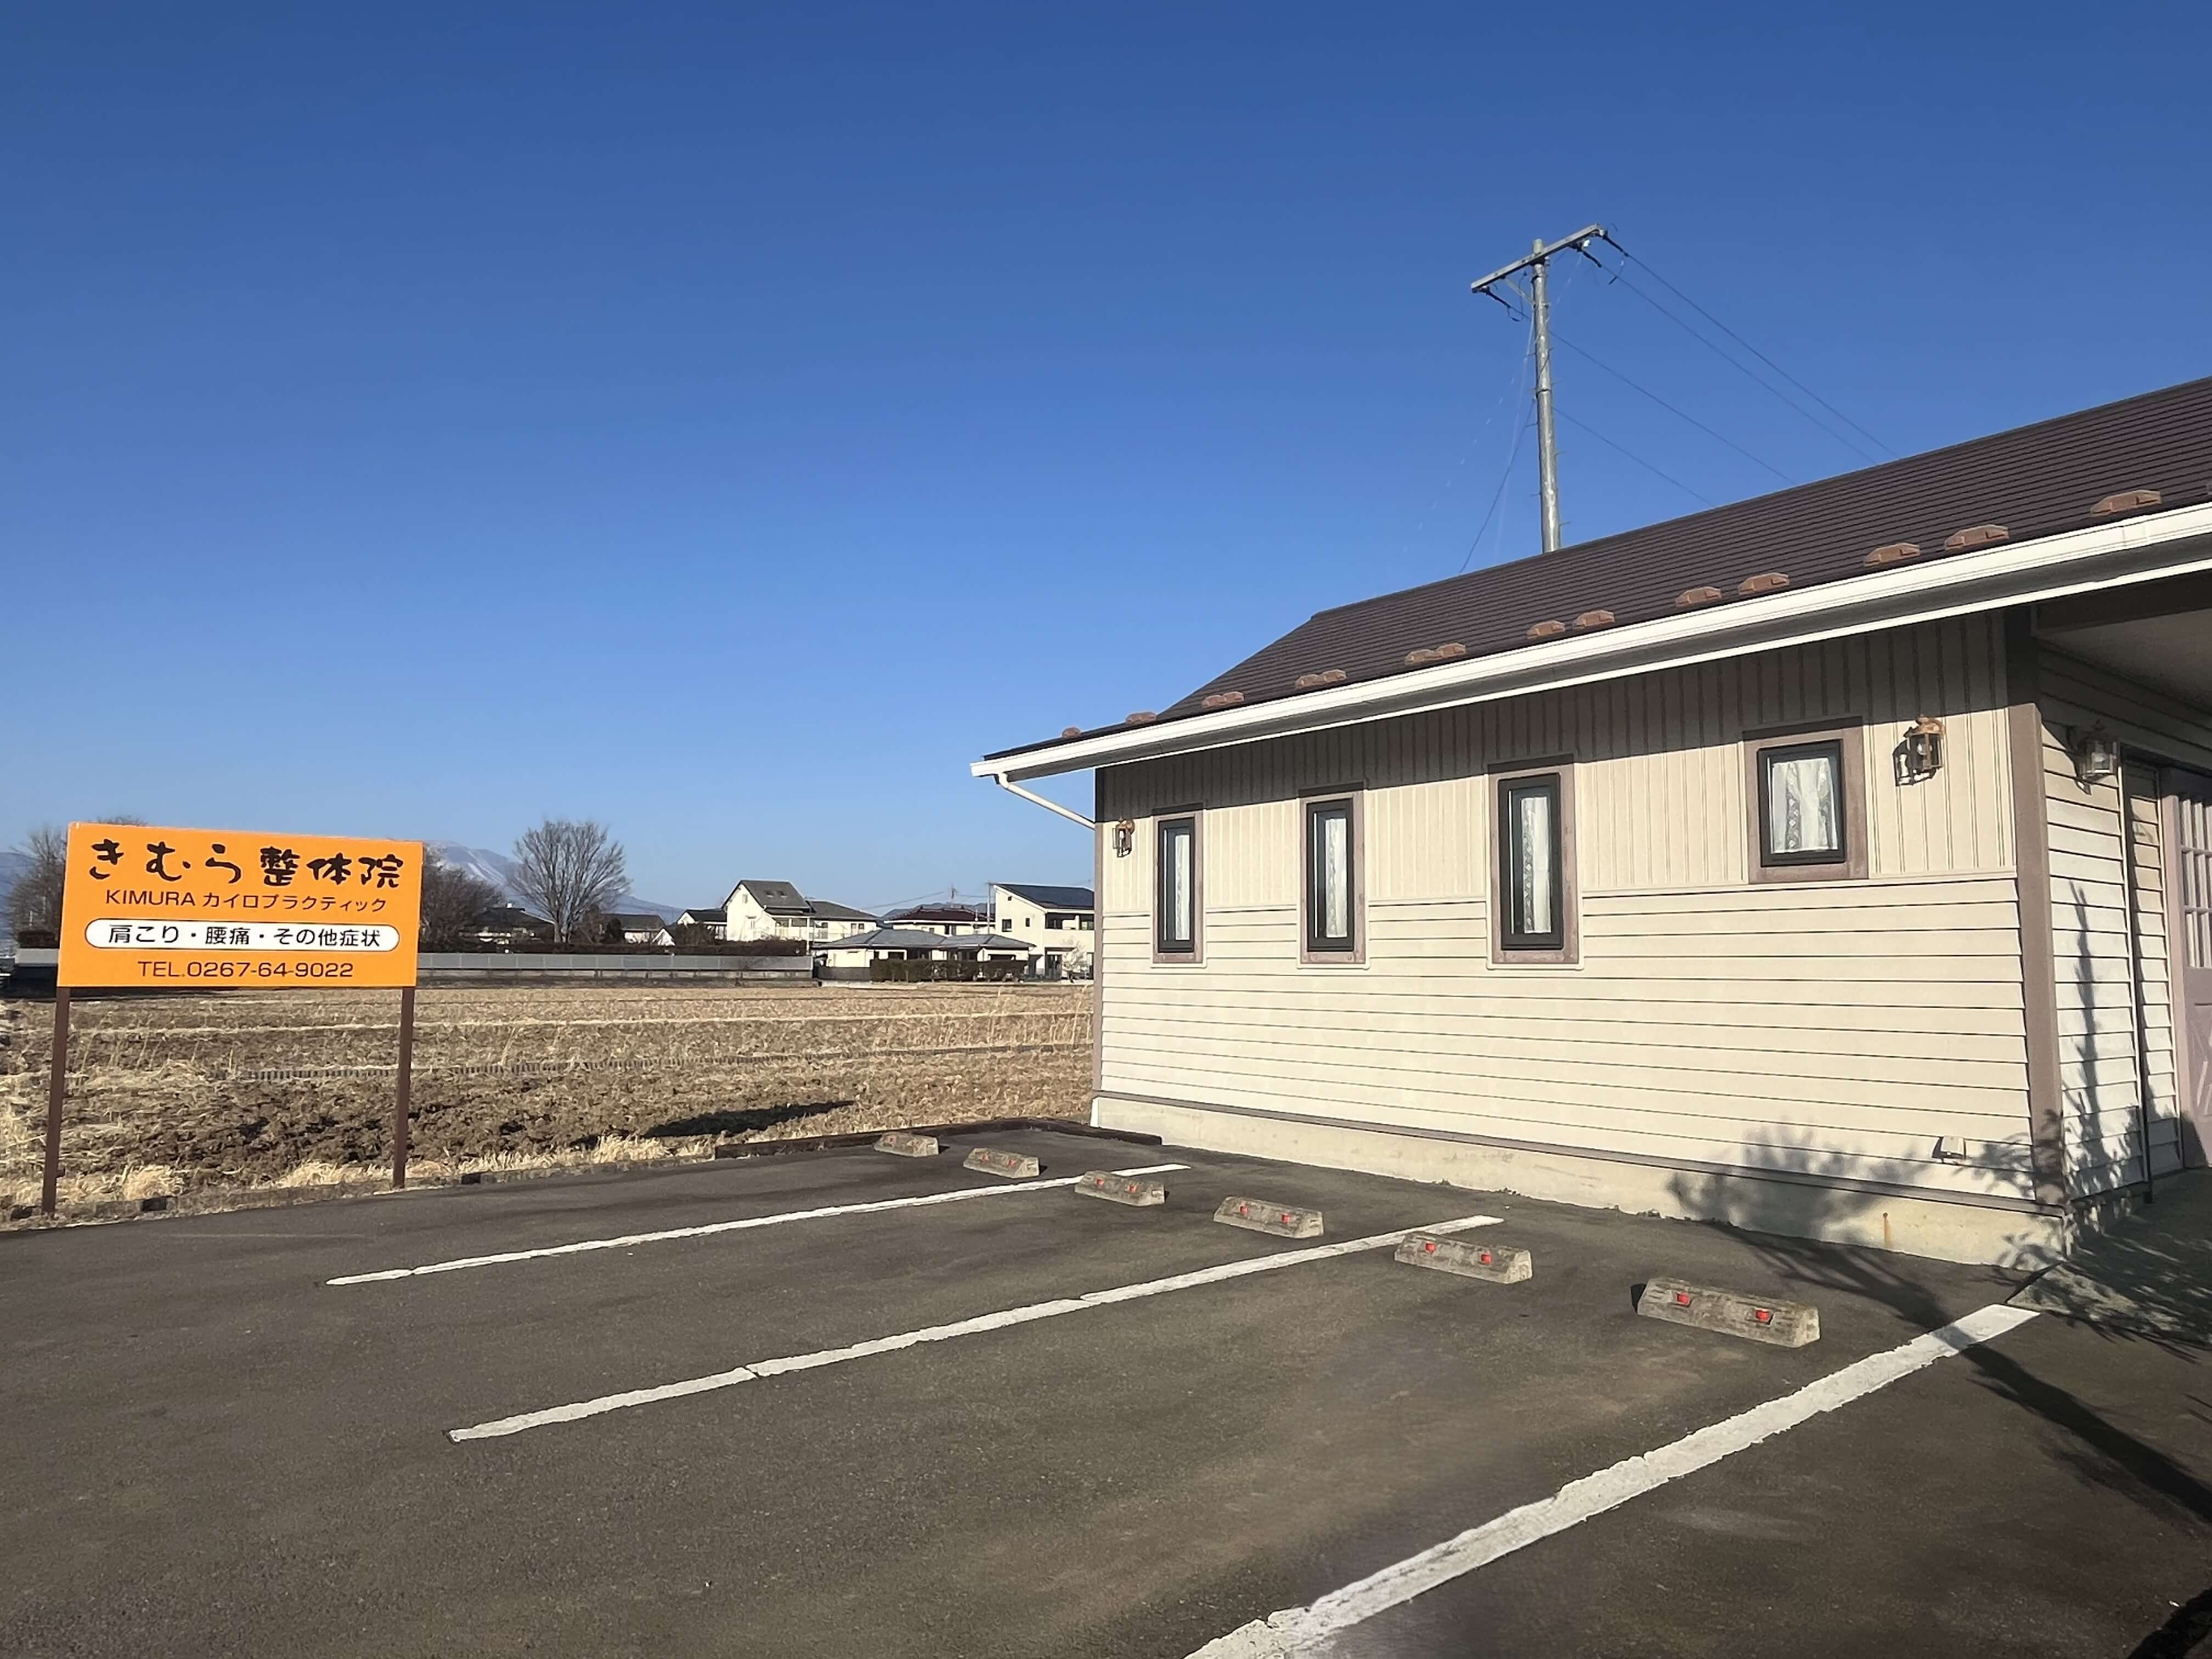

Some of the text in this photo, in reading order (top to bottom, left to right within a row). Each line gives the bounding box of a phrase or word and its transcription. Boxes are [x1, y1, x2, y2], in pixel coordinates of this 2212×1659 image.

[89, 838, 404, 888] きむら整体院
[106, 890, 386, 912] KIMURA カイロプラクティック
[109, 924, 381, 947] 肩こり・腰痛・その他症状
[137, 961, 354, 978] TEL.0267-64-9022
